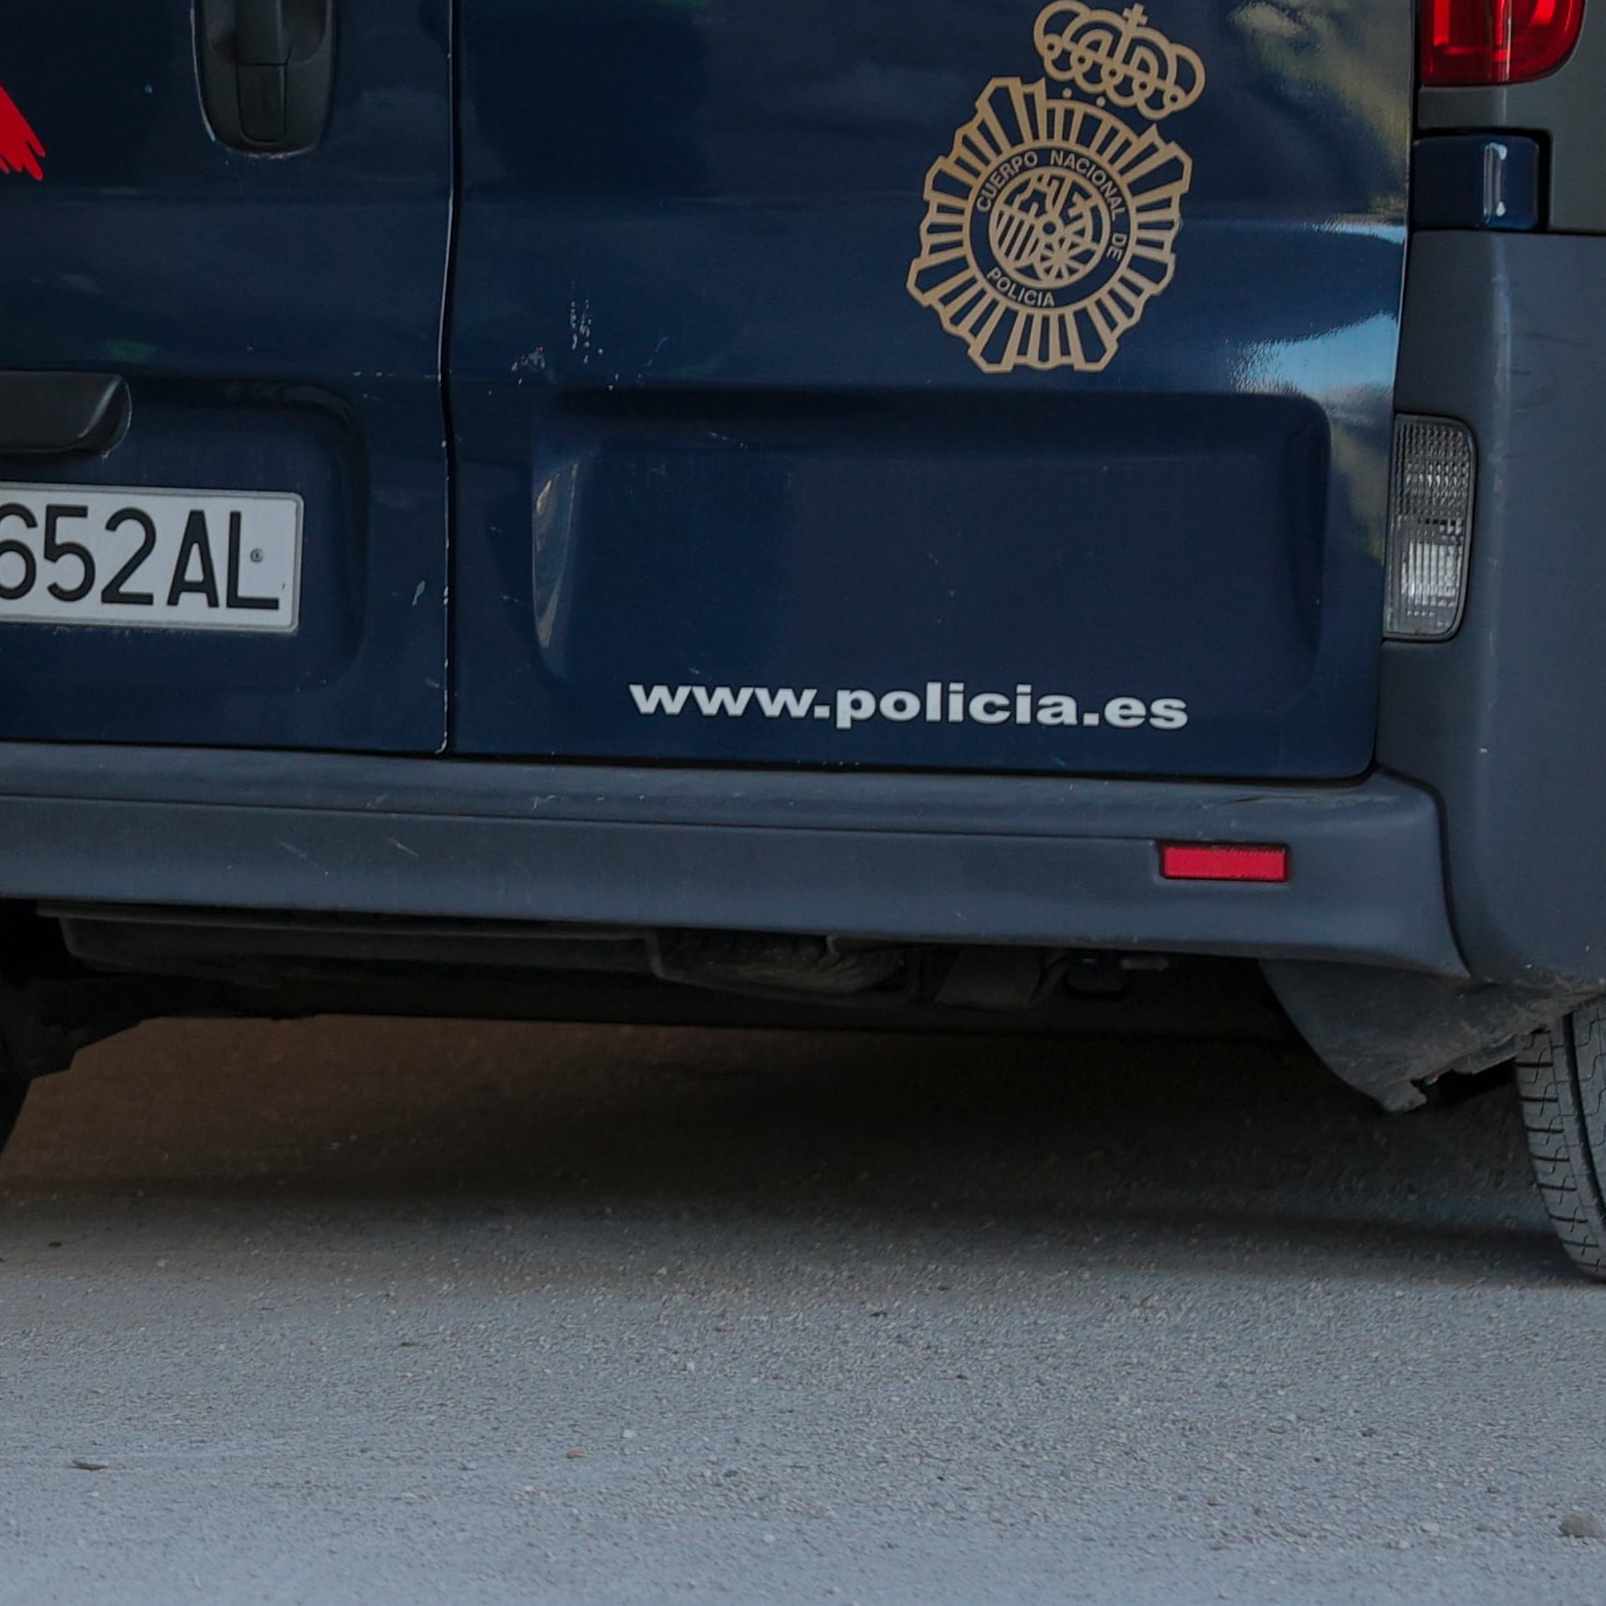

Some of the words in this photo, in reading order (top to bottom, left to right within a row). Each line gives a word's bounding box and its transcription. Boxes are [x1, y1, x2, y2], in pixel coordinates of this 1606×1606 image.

[975, 150, 1039, 213] CUERPO
[1049, 149, 1126, 221] NACIONAL
[1106, 232, 1128, 262] DE
[986, 266, 1056, 308] POLICIA
[628, 681, 1189, 730] www.policia.es
